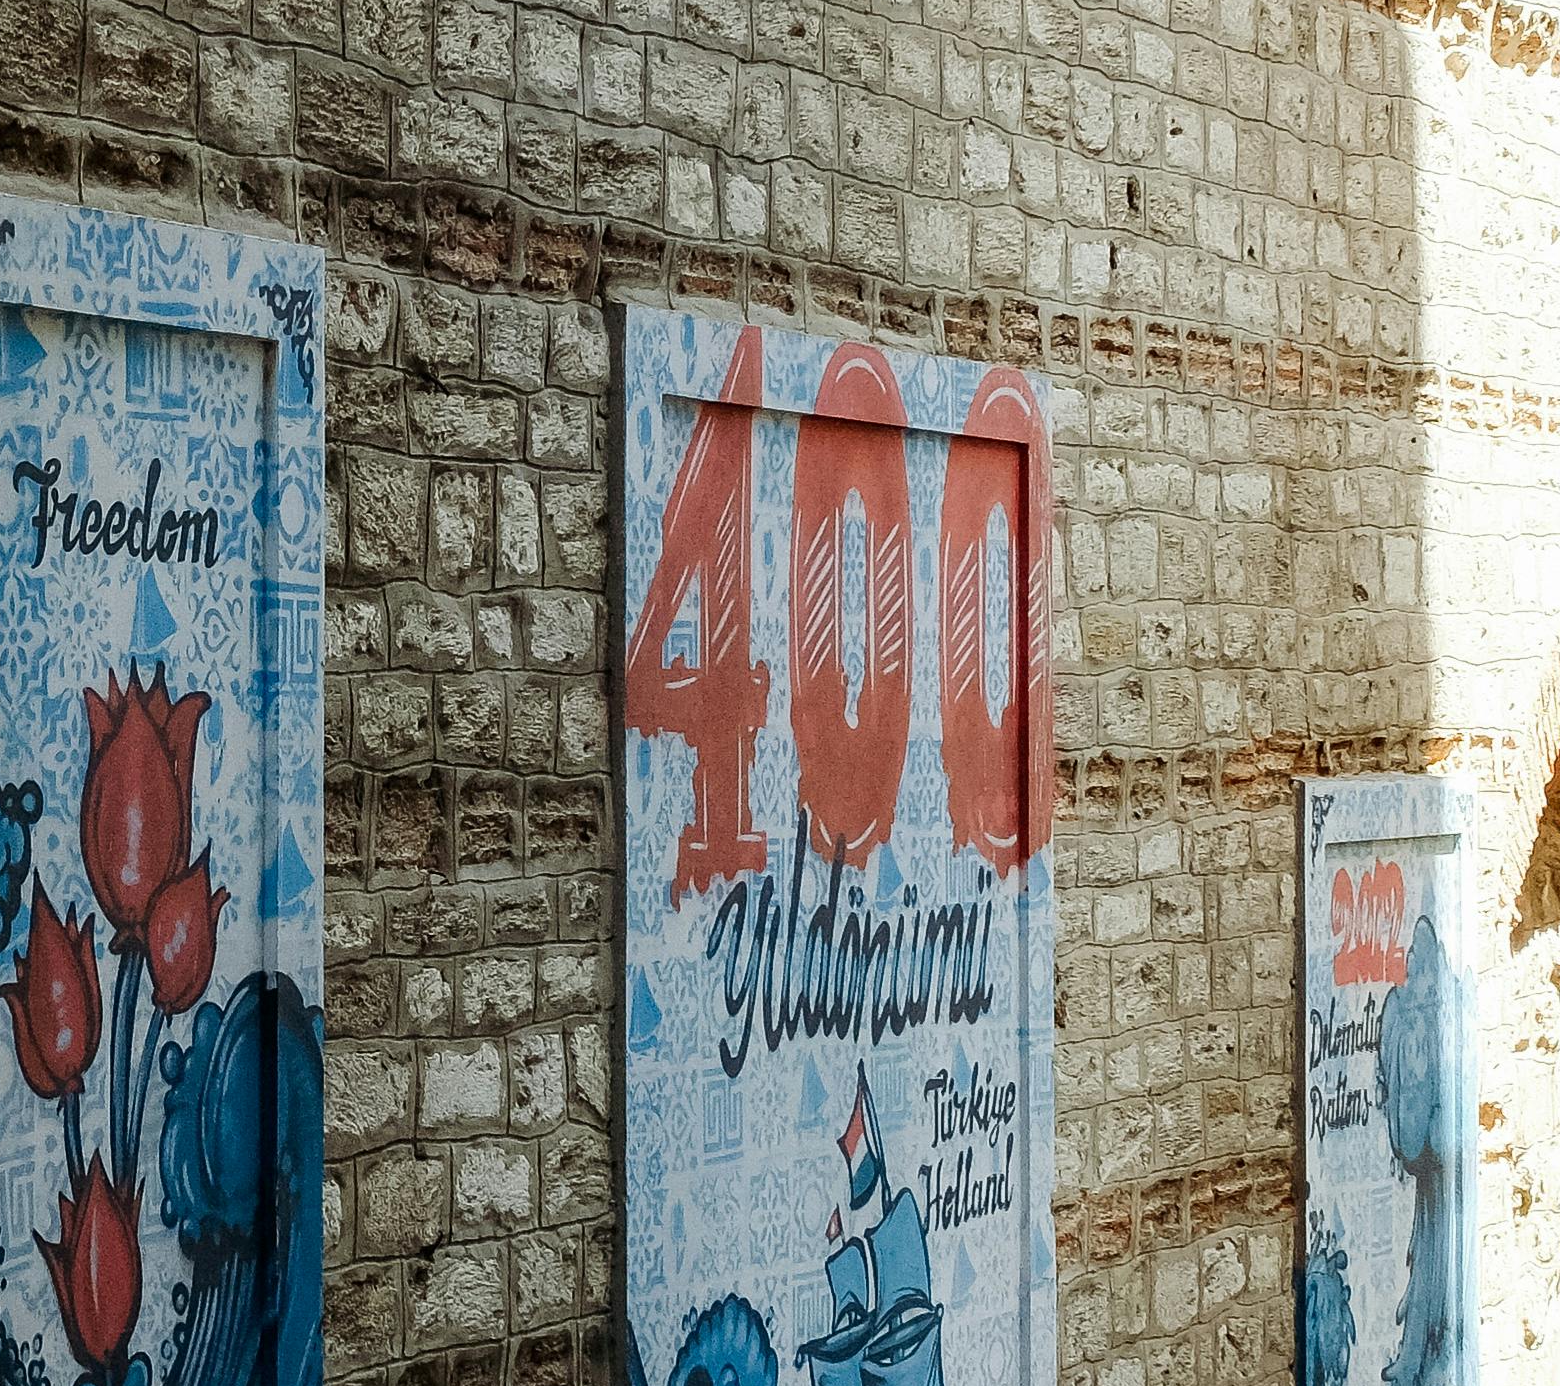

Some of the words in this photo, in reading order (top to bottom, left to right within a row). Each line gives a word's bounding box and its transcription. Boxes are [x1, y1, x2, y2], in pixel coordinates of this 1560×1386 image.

[13, 457, 220, 570] Freedom
[626, 324, 1055, 913] 400
[922, 1061, 1016, 1149] Türkiye
[917, 1155, 1014, 1235] Holland
